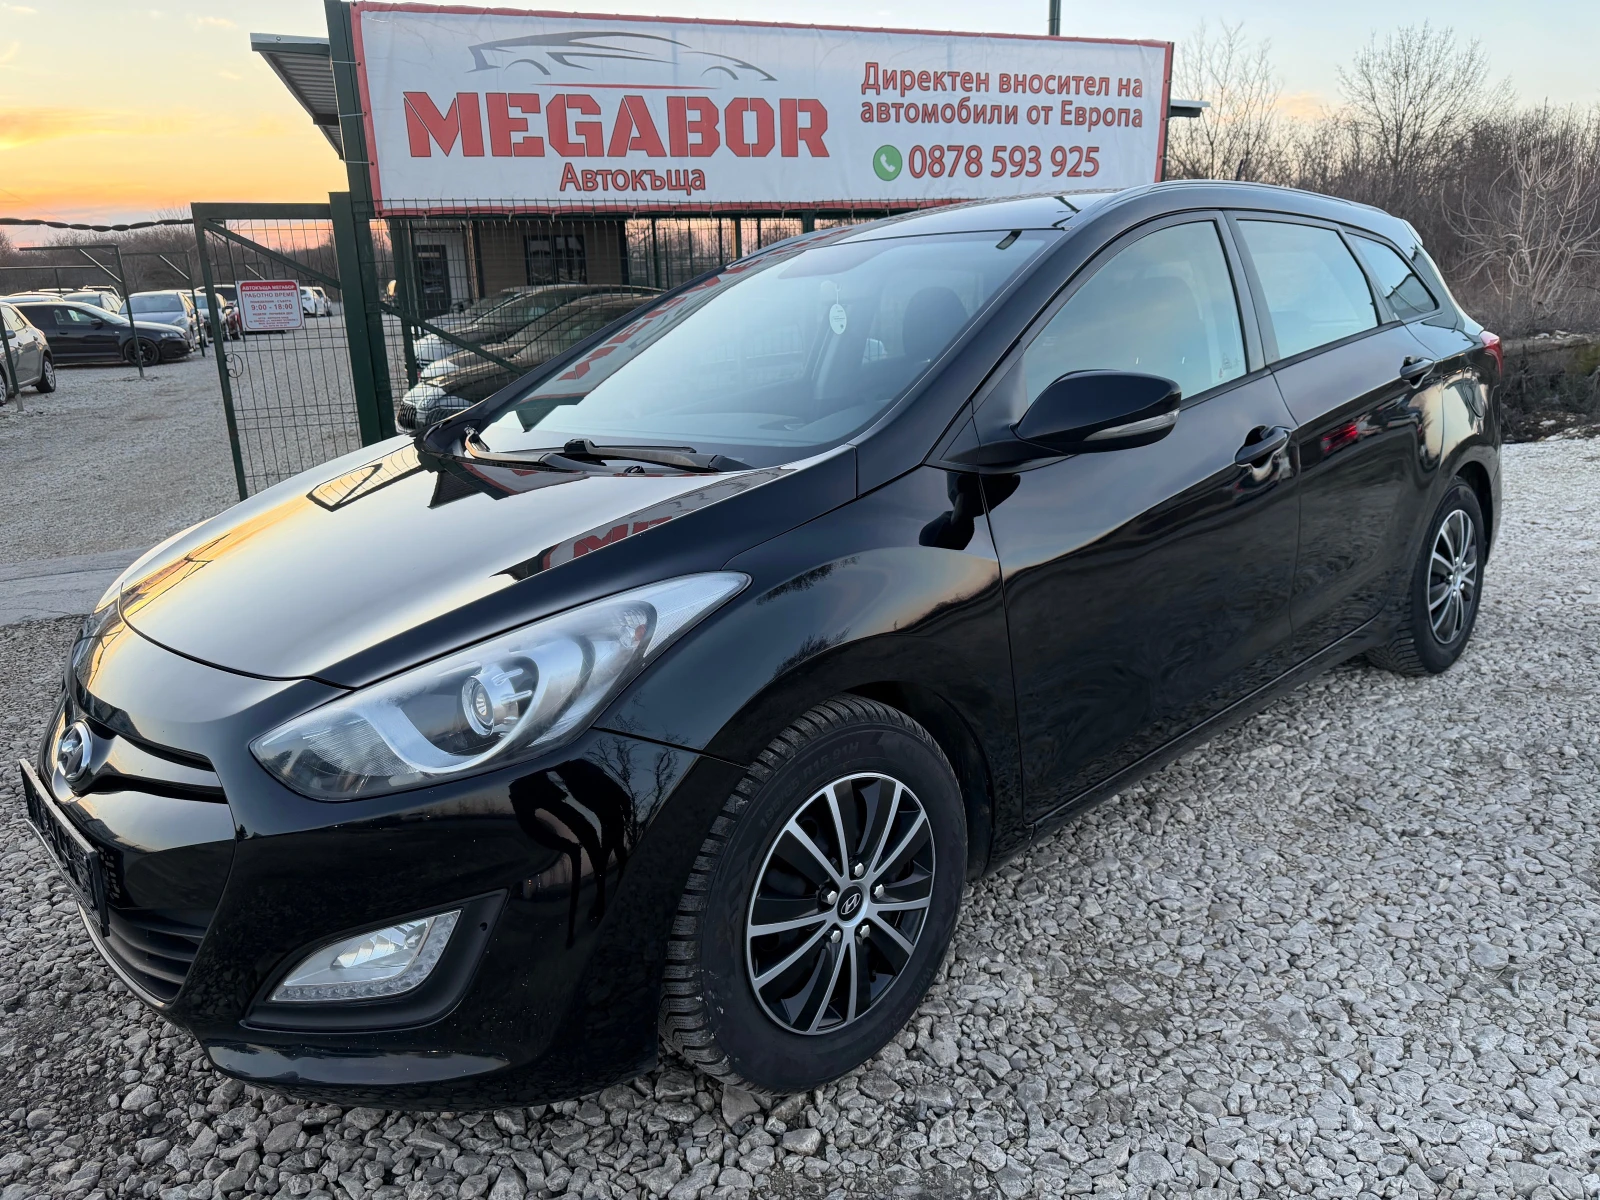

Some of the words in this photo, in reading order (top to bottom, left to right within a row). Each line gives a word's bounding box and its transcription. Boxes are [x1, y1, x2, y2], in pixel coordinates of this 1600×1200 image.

[861, 62, 989, 96] Директен
[999, 73, 1110, 96] вносител
[1118, 76, 1143, 98] на
[403, 91, 830, 157] MEGABOR
[860, 97, 1018, 124] автомобили
[1027, 105, 1053, 125] от
[1060, 100, 1143, 132] Европа
[559, 163, 706, 196] Автокъща
[908, 145, 983, 179] 0878
[991, 146, 1042, 178] 593
[1051, 146, 1100, 178] 925
